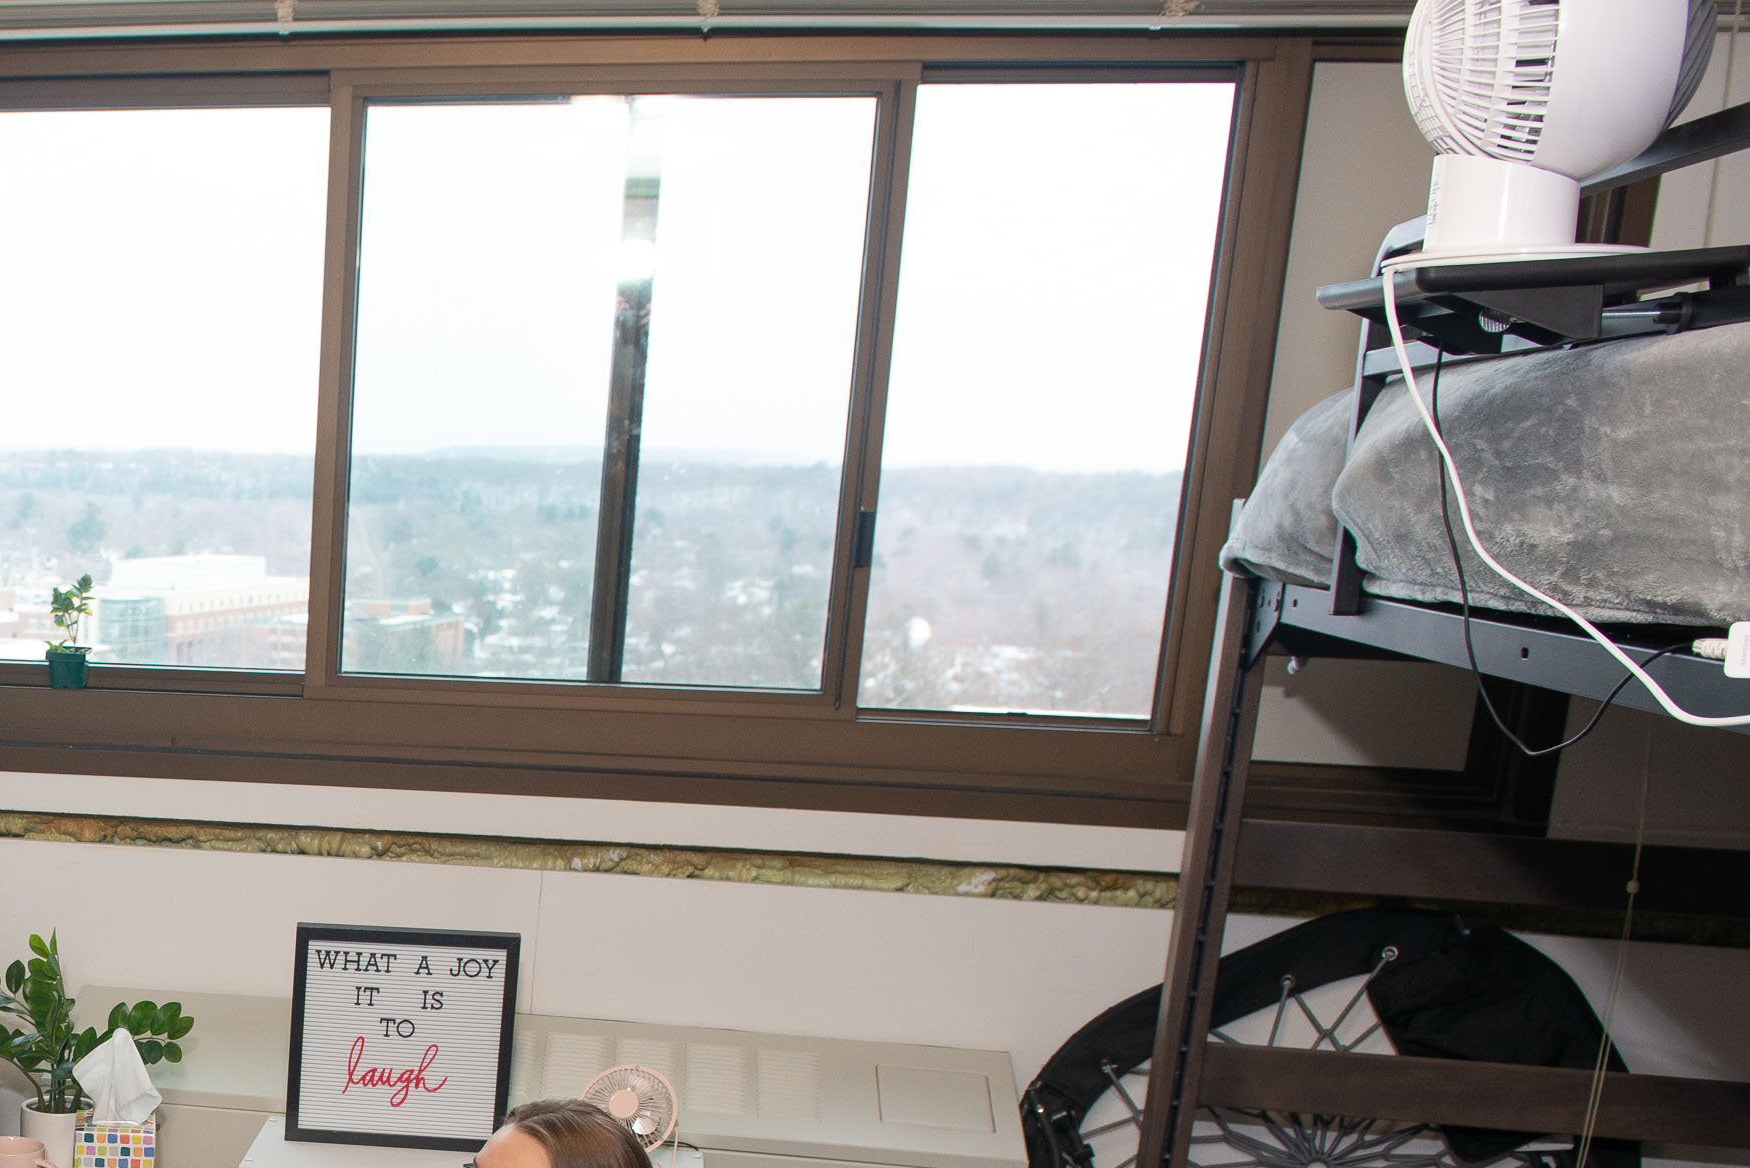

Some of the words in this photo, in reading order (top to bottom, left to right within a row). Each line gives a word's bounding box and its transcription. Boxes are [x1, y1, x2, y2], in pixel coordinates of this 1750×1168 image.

[315, 949, 397, 975] WHAT
[414, 955, 433, 976] A
[449, 957, 500, 979] JOY
[354, 986, 380, 1007] IT
[420, 990, 445, 1010] IS
[380, 1018, 416, 1038] TO
[342, 1035, 449, 1107] laugh
